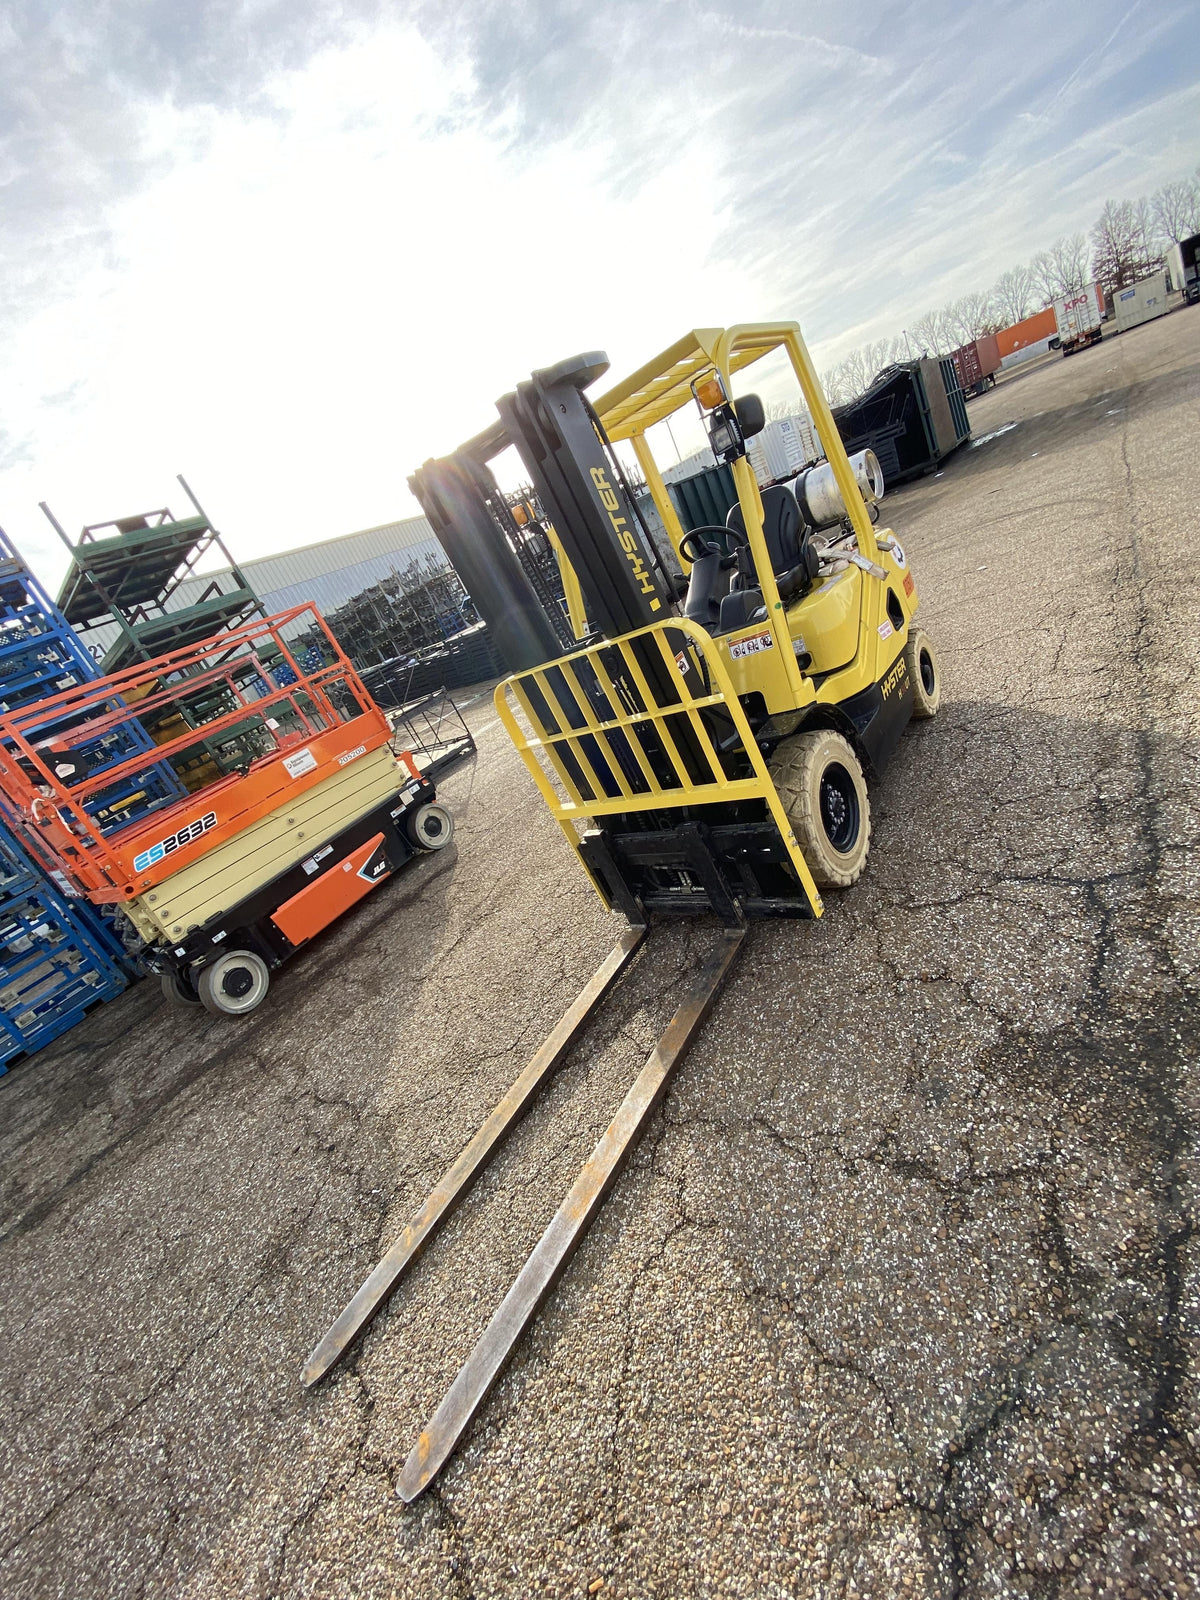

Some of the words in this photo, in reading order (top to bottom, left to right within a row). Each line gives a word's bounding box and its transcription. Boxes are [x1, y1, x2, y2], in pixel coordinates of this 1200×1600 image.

[1063, 294, 1088, 312] XPO
[589, 467, 655, 595] HYSTER
[88, 643, 107, 659] 21
[880, 657, 907, 701] HYSTER
[339, 746, 365, 765] 205200
[134, 811, 217, 872] ES2632
[373, 860, 386, 876] JLG
